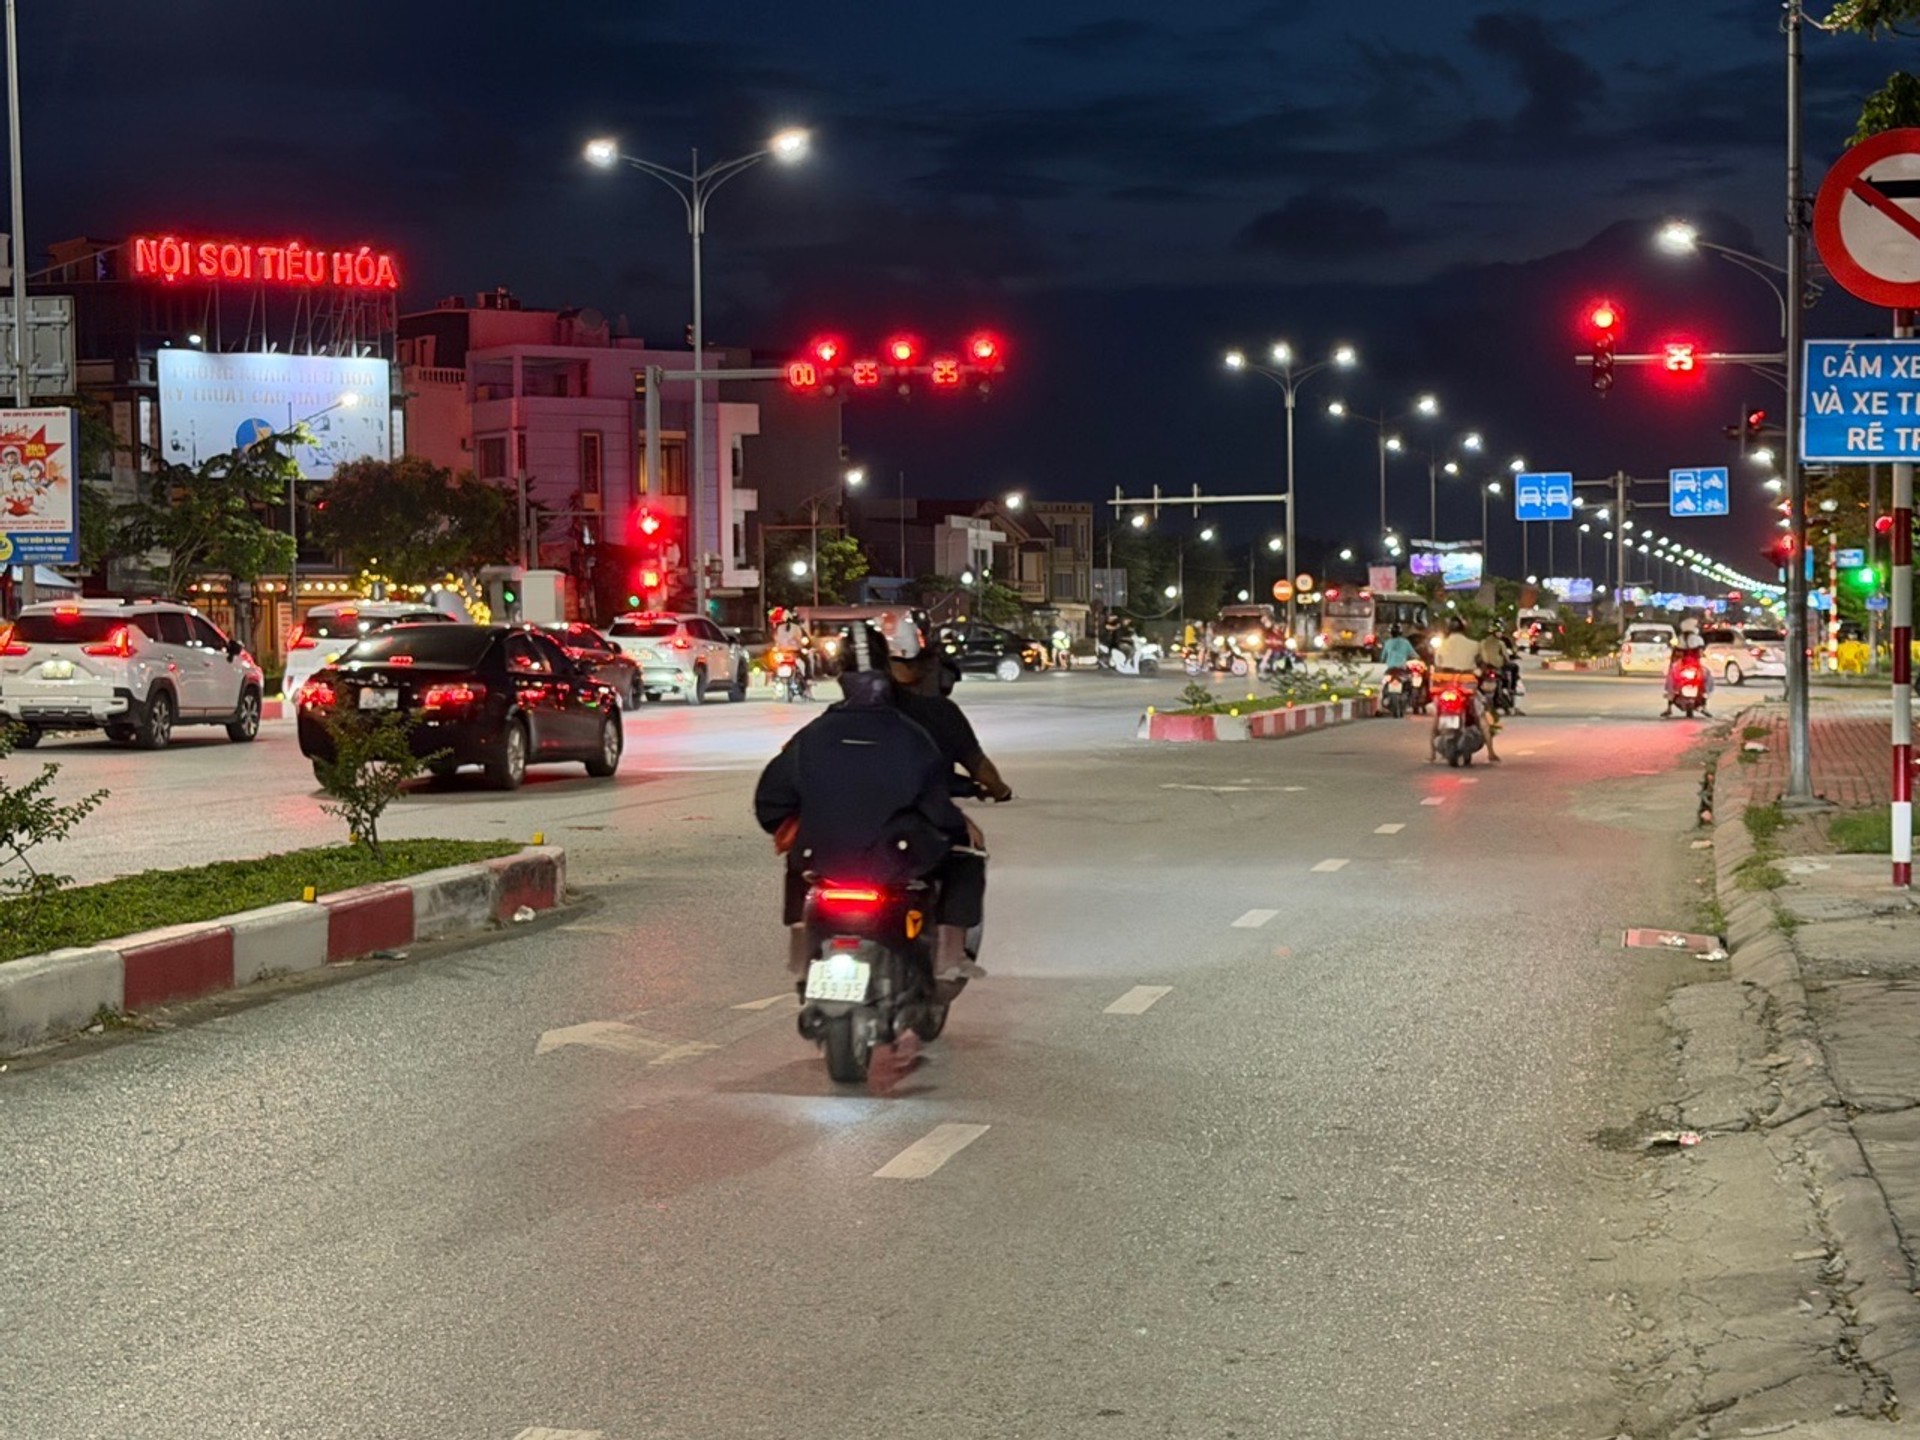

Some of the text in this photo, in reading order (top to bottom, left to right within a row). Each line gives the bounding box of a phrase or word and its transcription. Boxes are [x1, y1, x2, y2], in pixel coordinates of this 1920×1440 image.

[135, 236, 398, 288] NỘI SOI TIÊU HÓA
[853, 361, 878, 385] 25
[932, 360, 958, 384] 25
[1822, 341, 1882, 379] CẤM
[1811, 384, 1920, 415] VÀ XE T
[1847, 420, 1885, 452] RẼ
